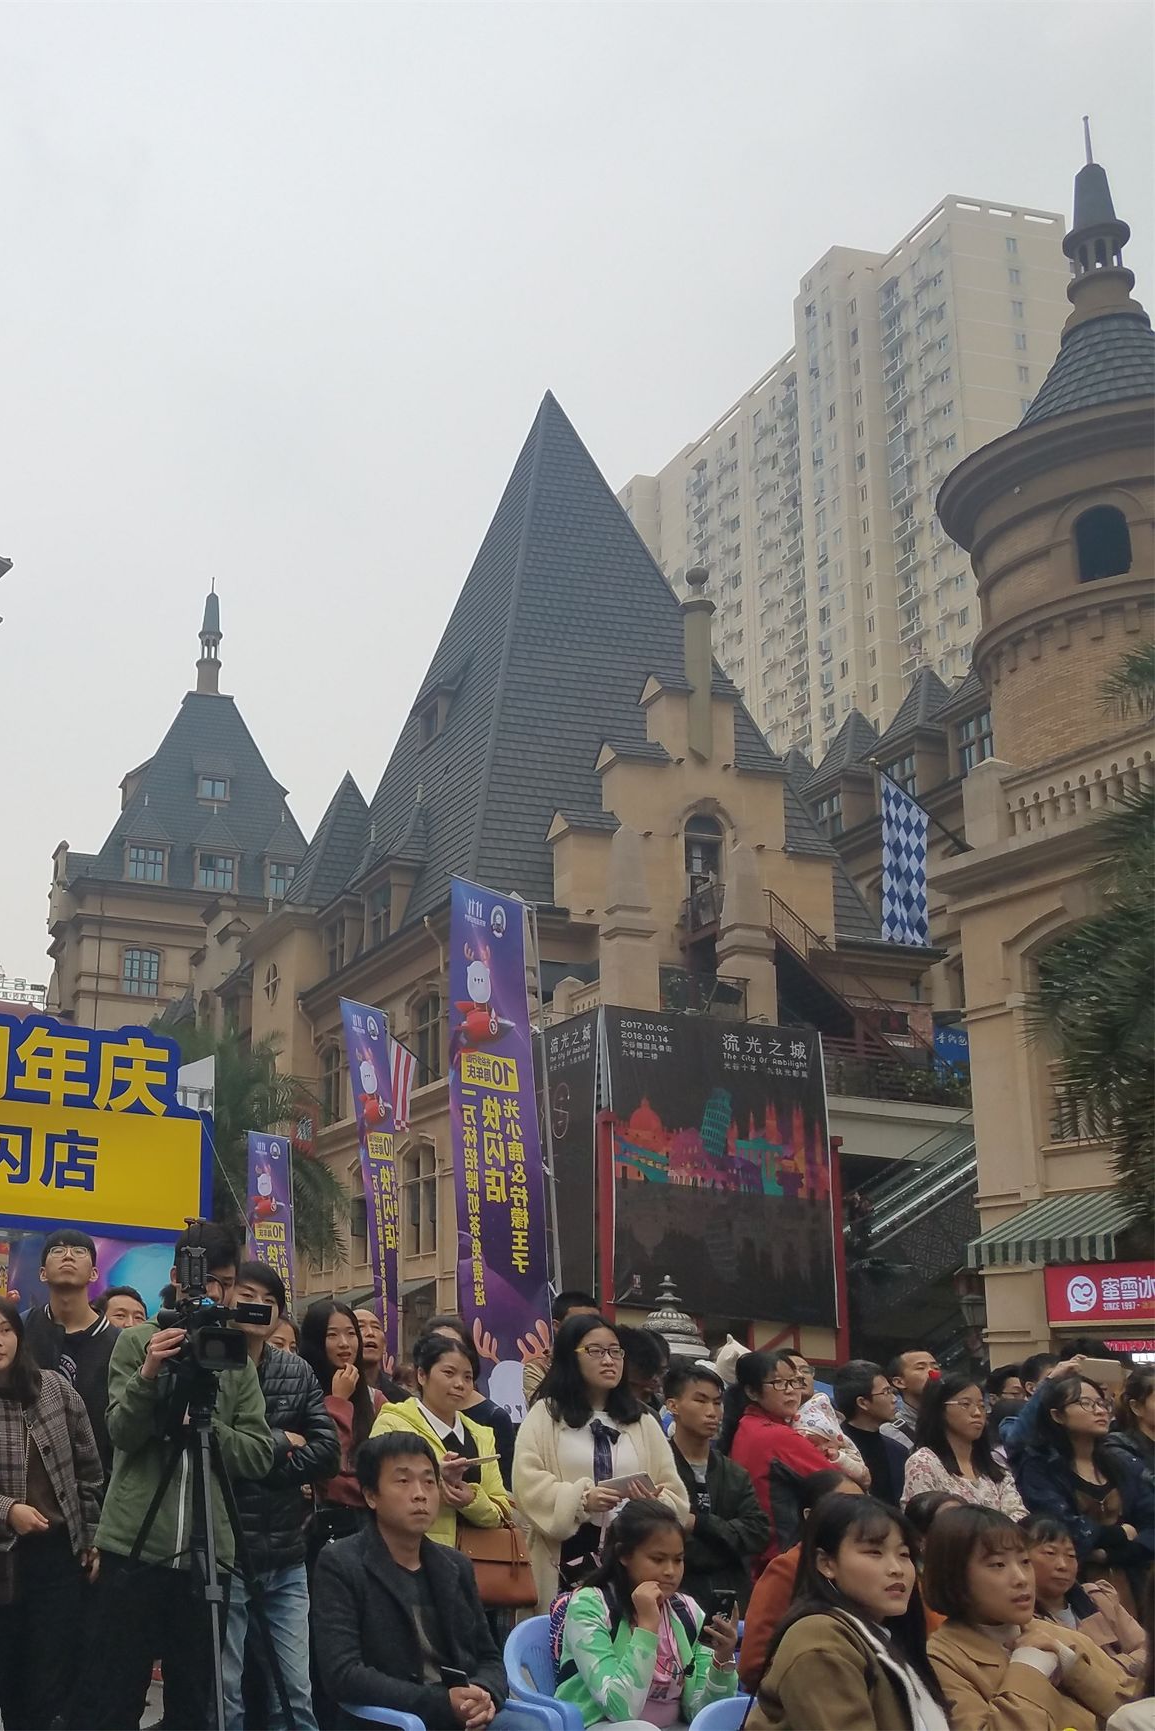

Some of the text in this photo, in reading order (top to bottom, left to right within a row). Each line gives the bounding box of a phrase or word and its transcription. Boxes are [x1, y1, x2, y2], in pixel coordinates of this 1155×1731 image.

[620, 1031, 669, 1043] 2018.01.14
[722, 1033, 807, 1060] 流光之城
[1102, 1302, 1121, 1311] SINCE
